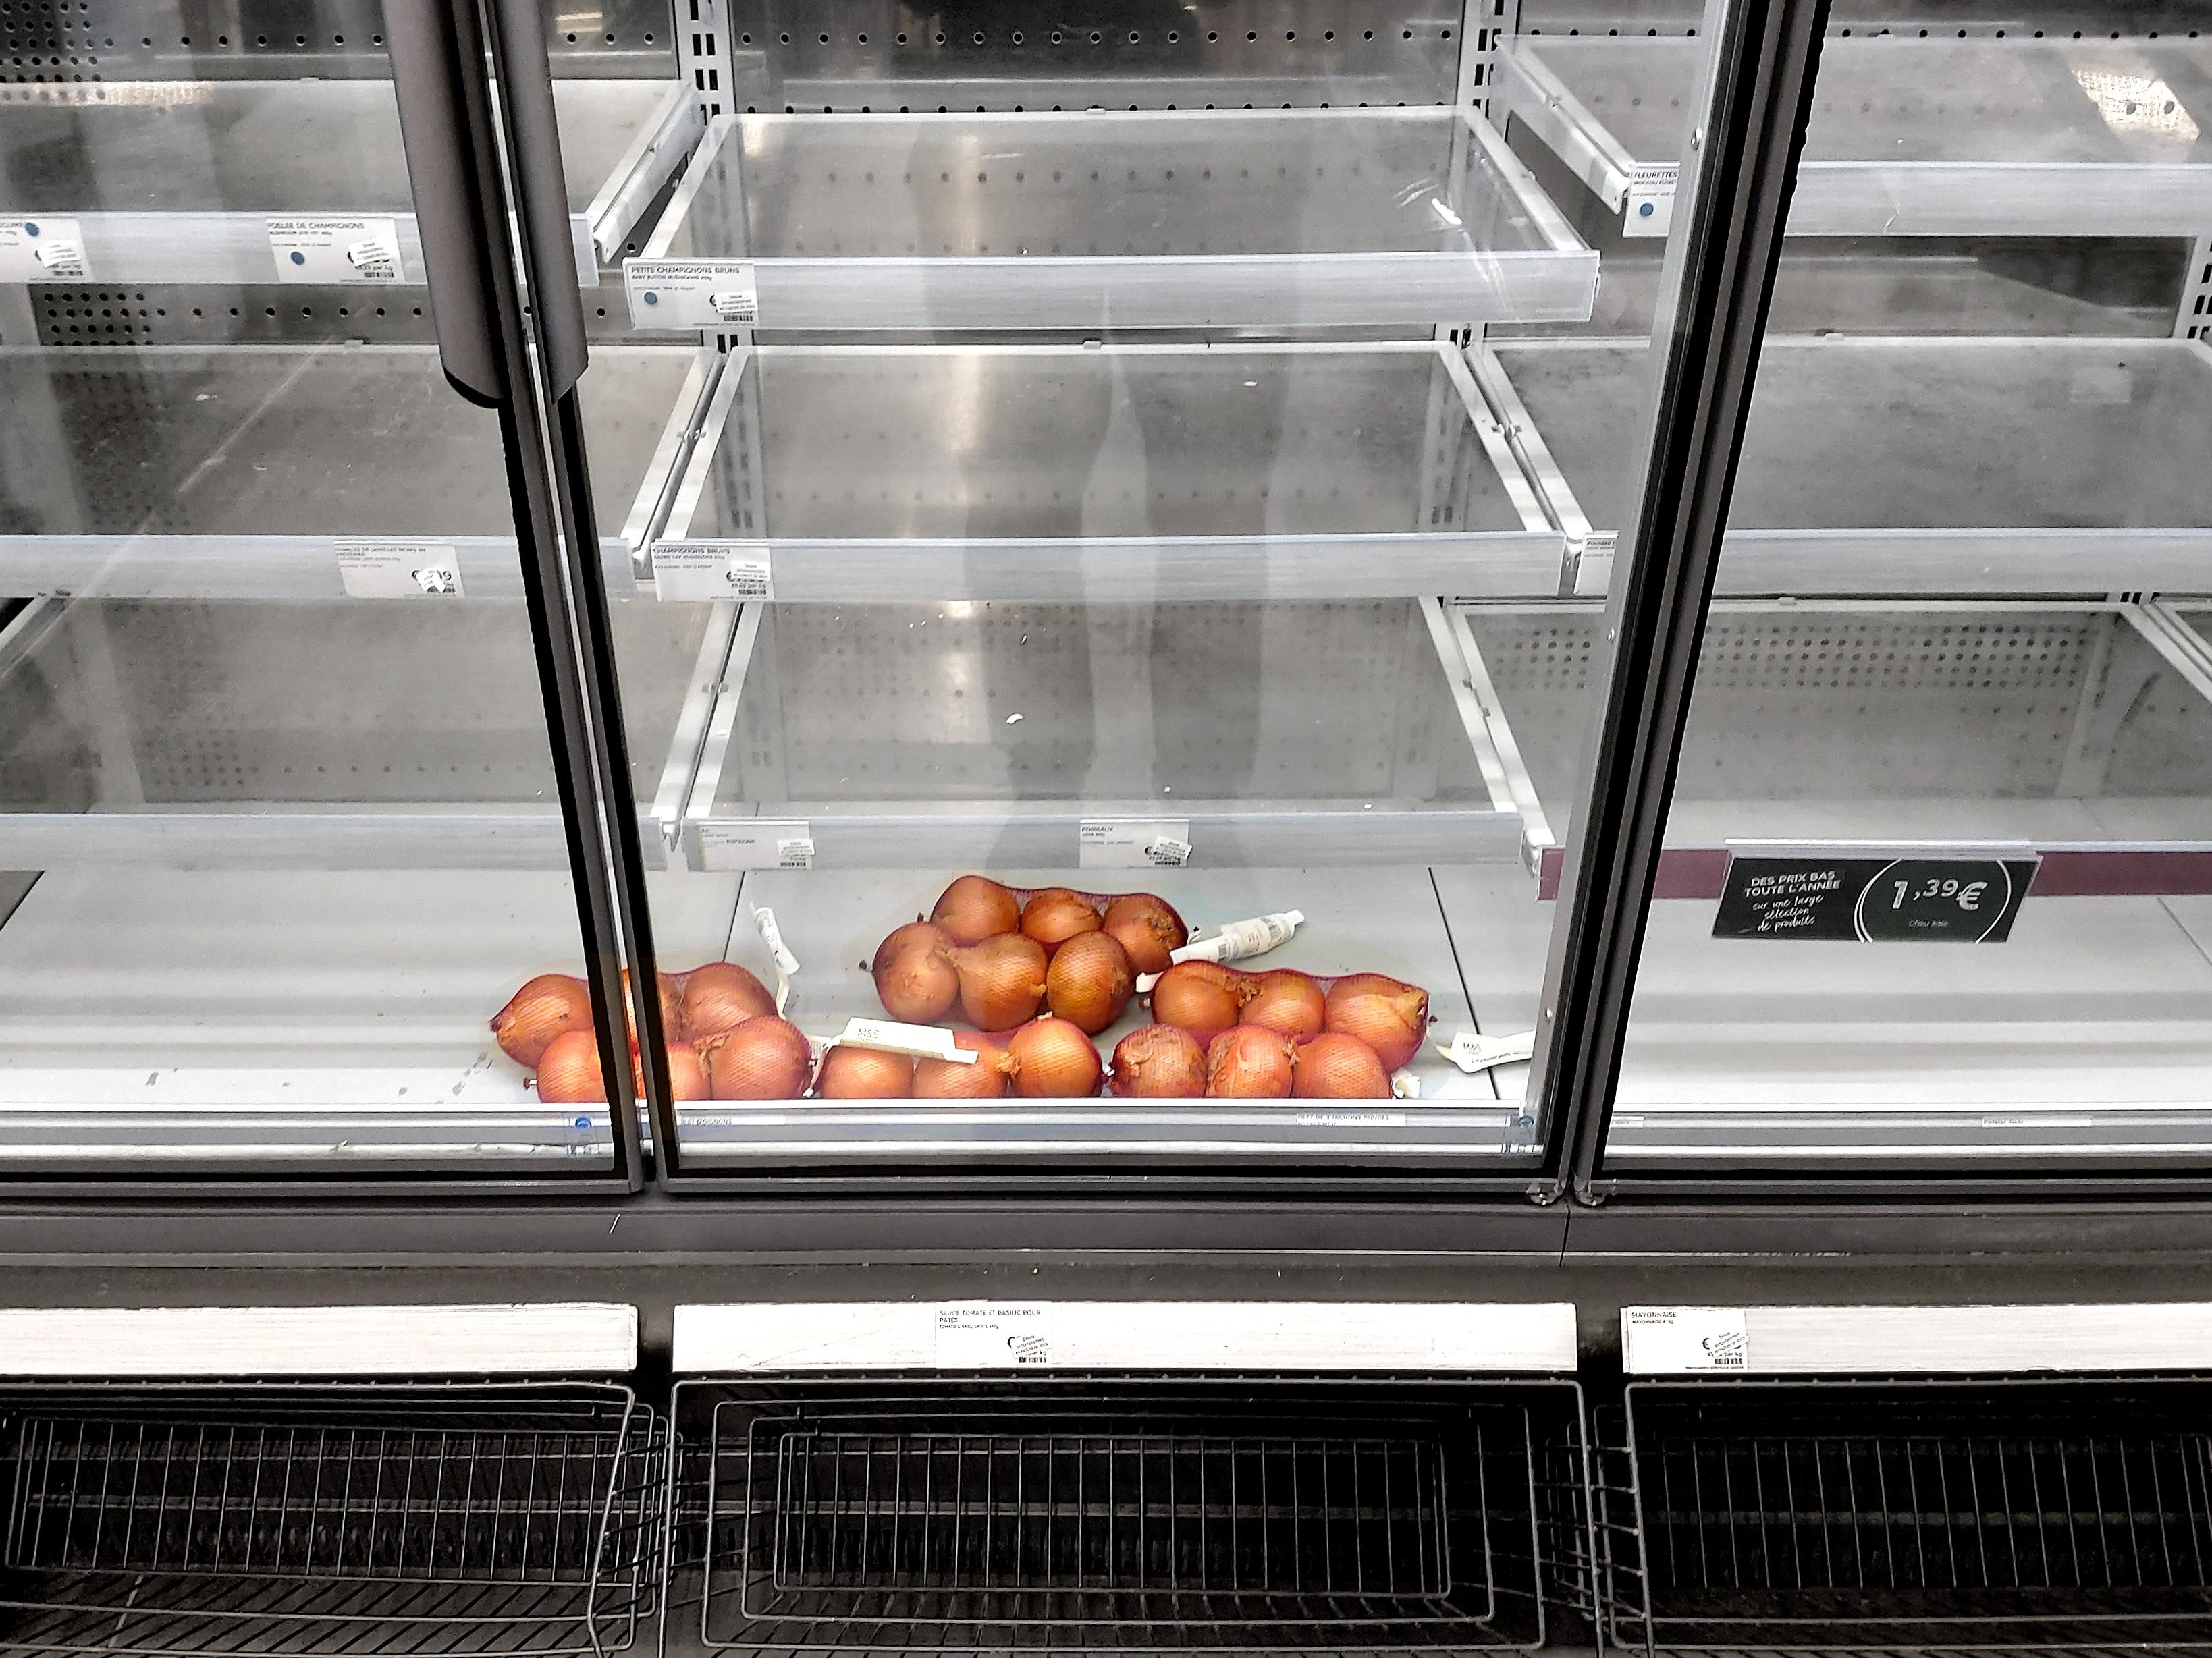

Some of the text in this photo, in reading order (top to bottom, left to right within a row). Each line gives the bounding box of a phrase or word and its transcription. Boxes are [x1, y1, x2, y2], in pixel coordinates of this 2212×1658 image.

[1751, 870, 1835, 887] DES PRIX BAS
[1744, 885, 1785, 897] TOUTE
[1752, 894, 1825, 911] sur une large
[1757, 915, 1816, 933] de produits
[857, 1028, 880, 1039] M&S
